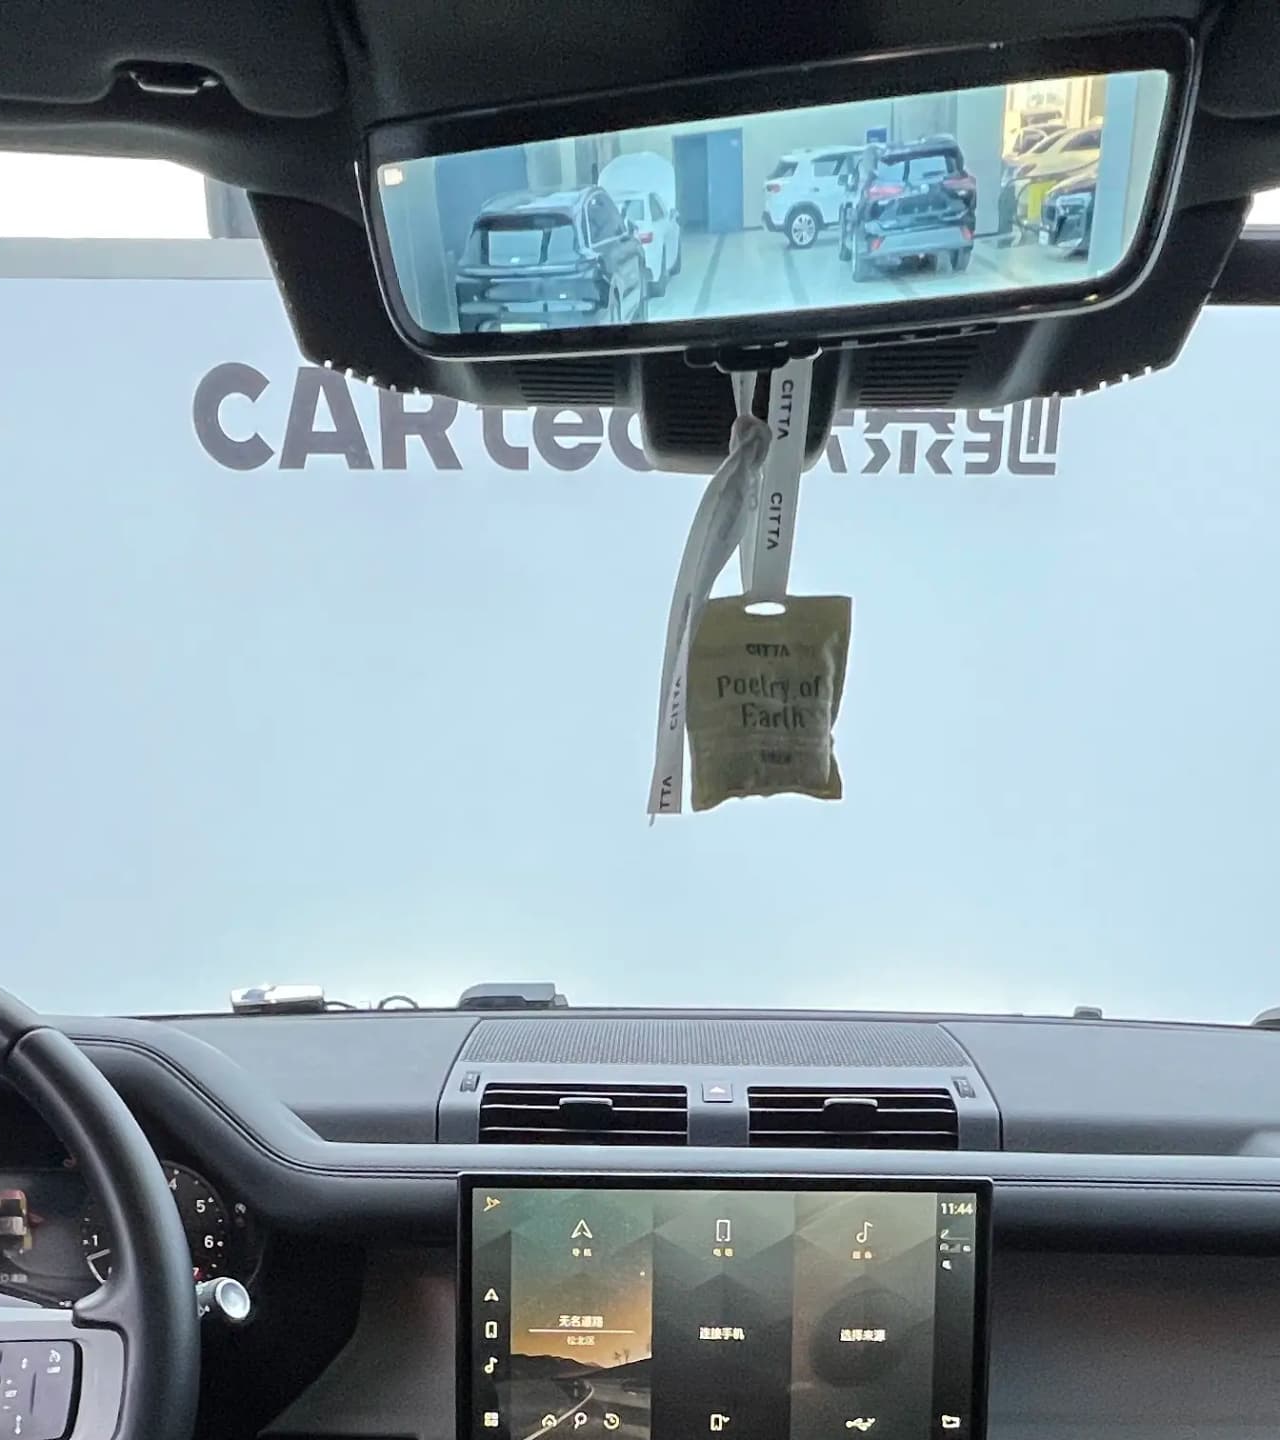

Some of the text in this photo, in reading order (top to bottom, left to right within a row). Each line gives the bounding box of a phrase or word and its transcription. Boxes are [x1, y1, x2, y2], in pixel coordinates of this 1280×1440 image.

[192, 361, 660, 471] CARtec
[717, 673, 821, 703] Poetry of
[741, 703, 806, 729] Earth
[196, 1199, 206, 1213] 5
[941, 1202, 974, 1215] 11:44
[91, 1235, 99, 1247] 1
[203, 1235, 214, 1248] 6
